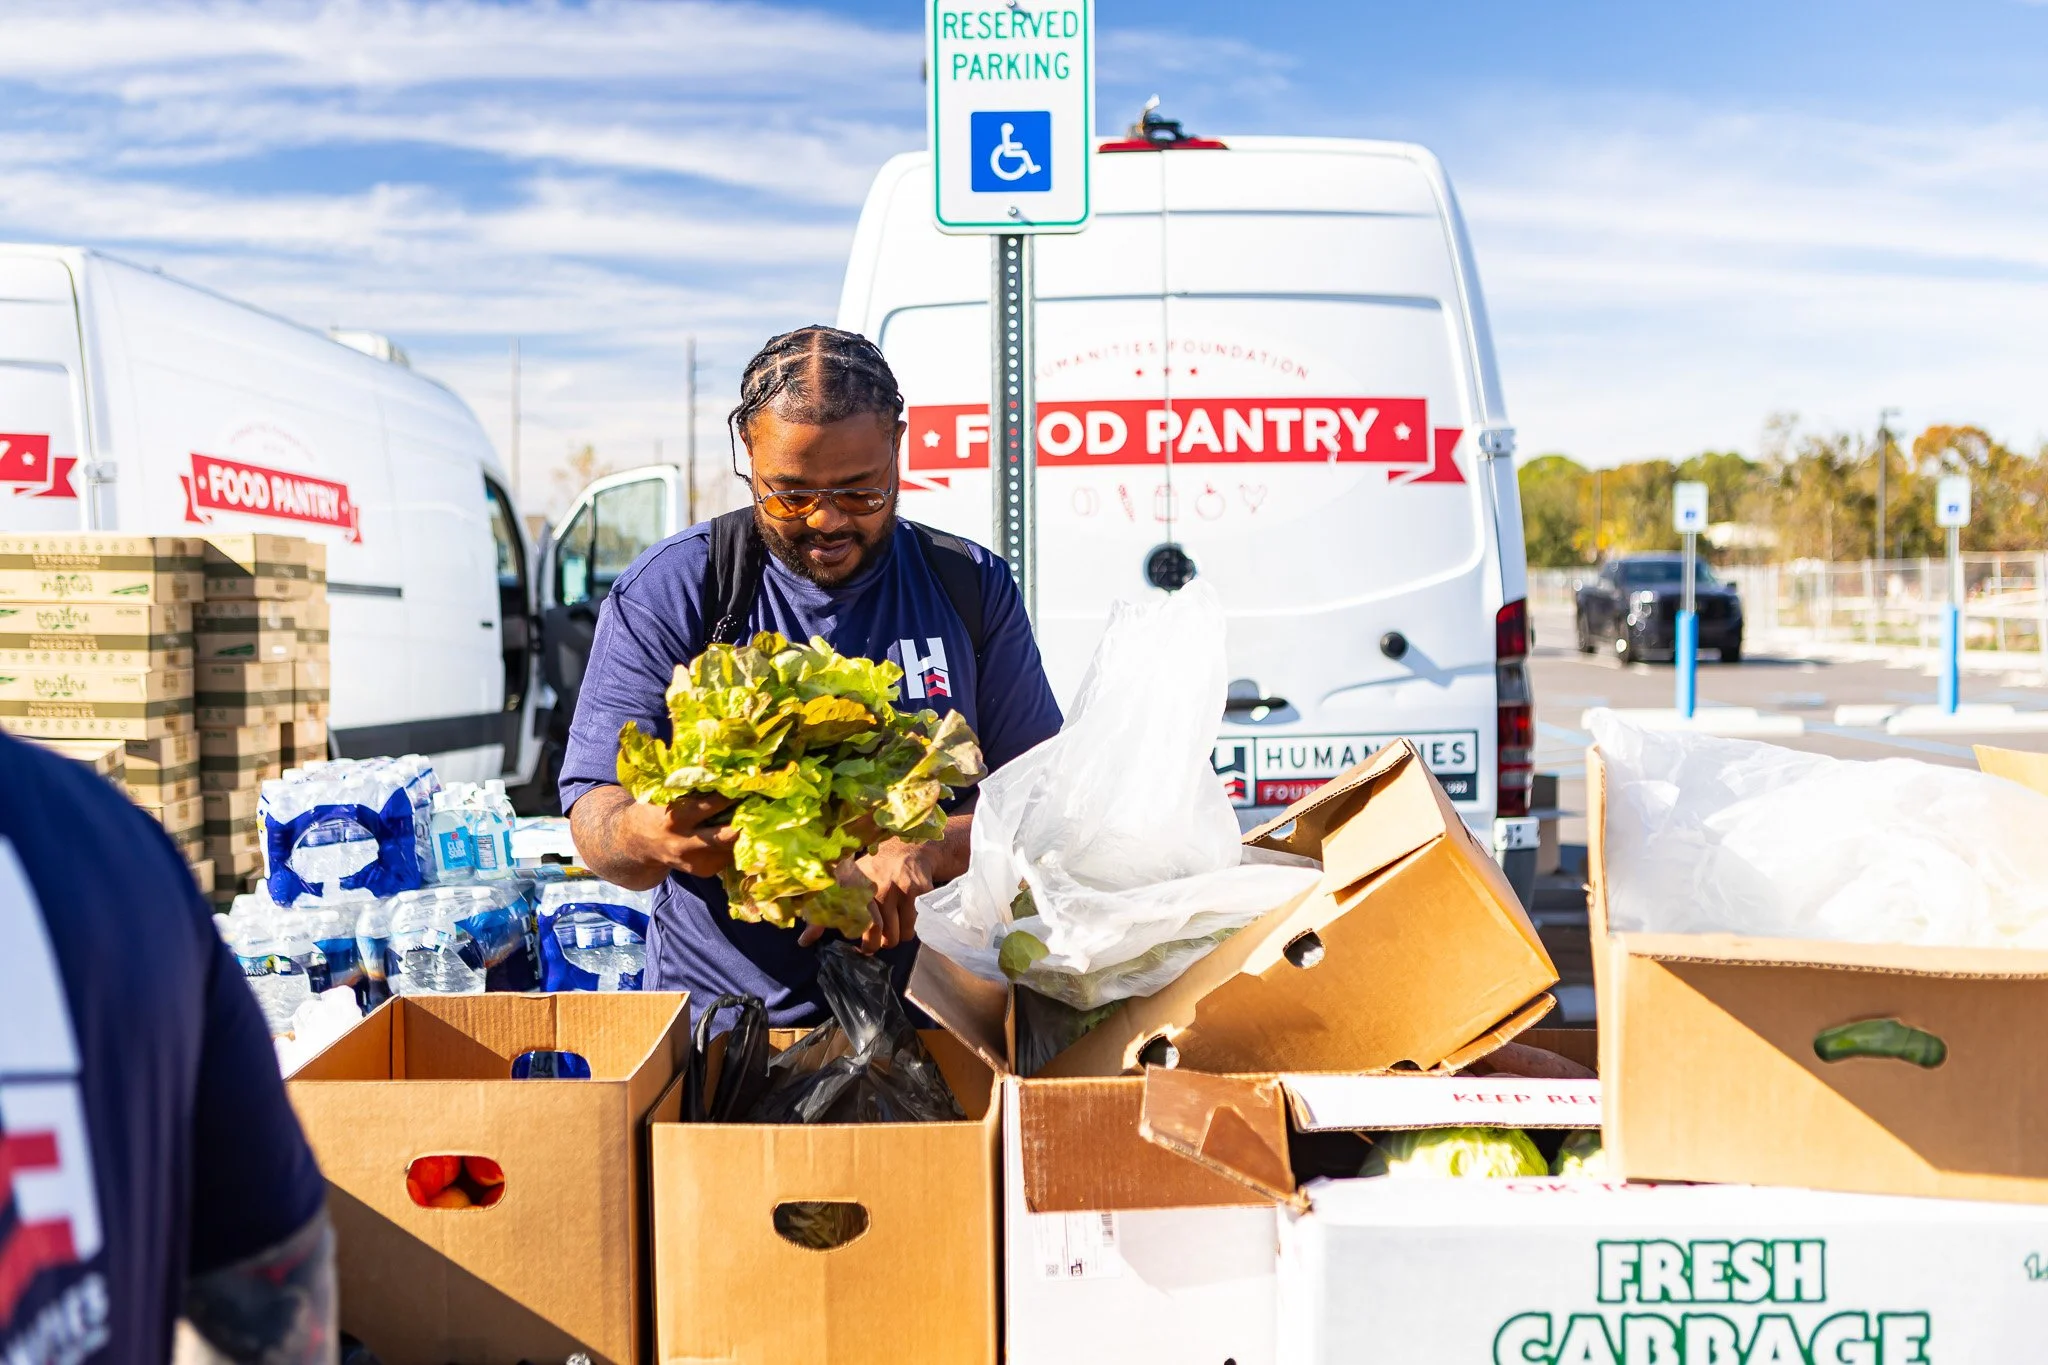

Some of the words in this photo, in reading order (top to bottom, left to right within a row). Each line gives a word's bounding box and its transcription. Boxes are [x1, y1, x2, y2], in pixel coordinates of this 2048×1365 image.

[943, 11, 1078, 40] RESERVED
[953, 52, 1070, 81] PARKING
[1034, 341, 1158, 381] UMANITIES
[1166, 340, 1309, 380] FOUNDATION
[955, 410, 1128, 459] FOD
[1146, 408, 1380, 455] PANTRY
[207, 463, 271, 510] FOOD
[270, 475, 340, 521] PANTRY
[1266, 741, 1468, 770] HUMANIES
[1452, 1092, 1531, 1105] KEEP
[1547, 1094, 1602, 1106] REF
[1597, 1239, 1826, 1304] FRESH
[1492, 1311, 1932, 1365] CABBAGE
